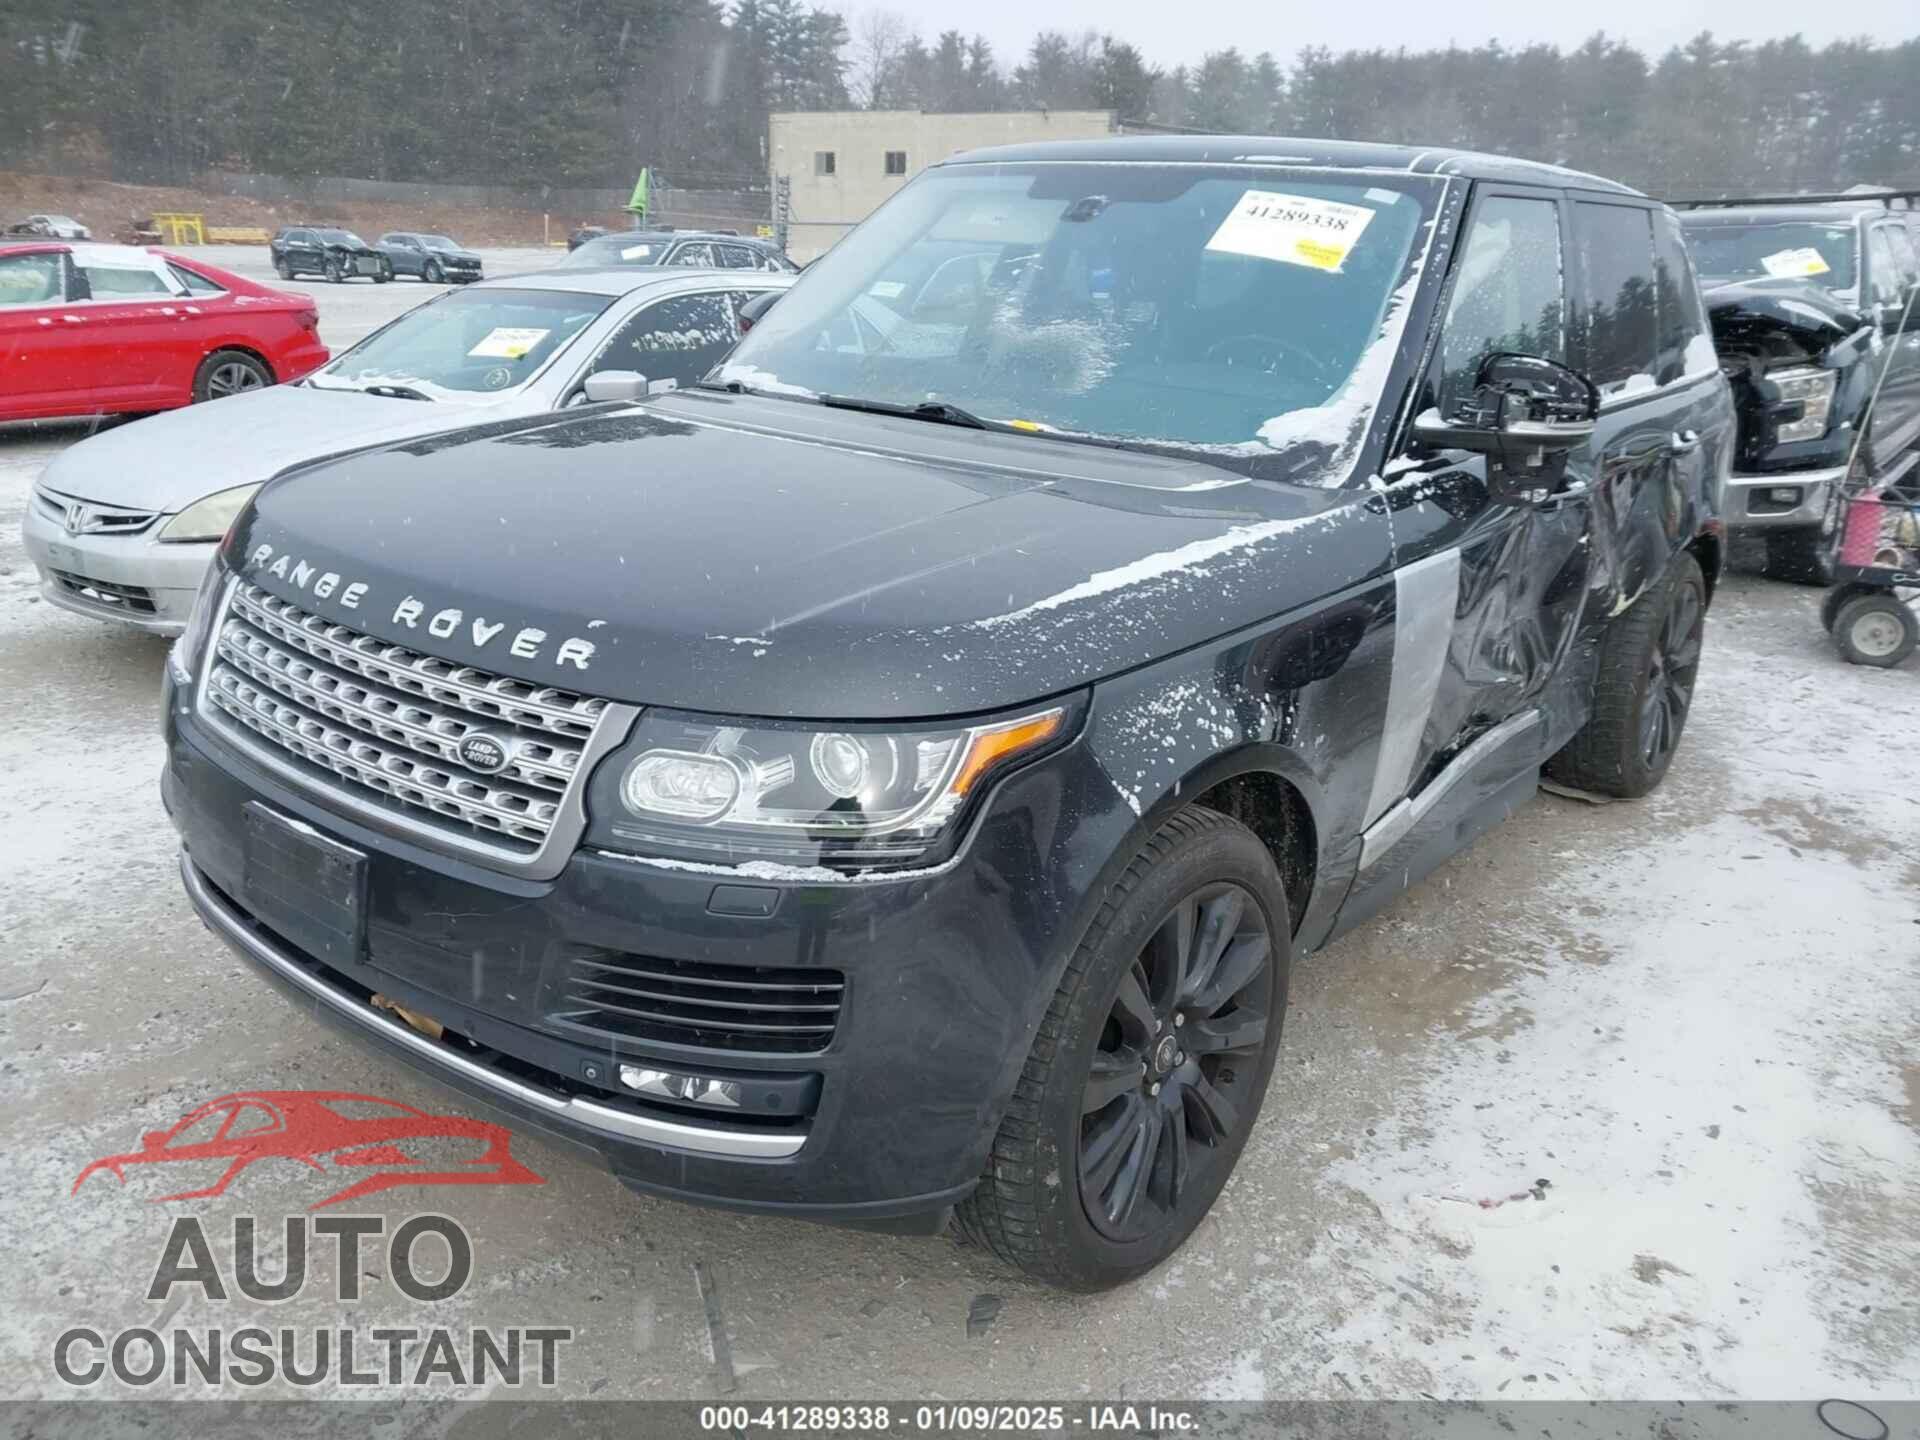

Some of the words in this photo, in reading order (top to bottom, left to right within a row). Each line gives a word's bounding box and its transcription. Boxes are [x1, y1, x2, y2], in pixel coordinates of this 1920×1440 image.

[1246, 205, 1349, 231] 41289338
[252, 544, 369, 608] RANGE
[392, 596, 596, 669] ROVER
